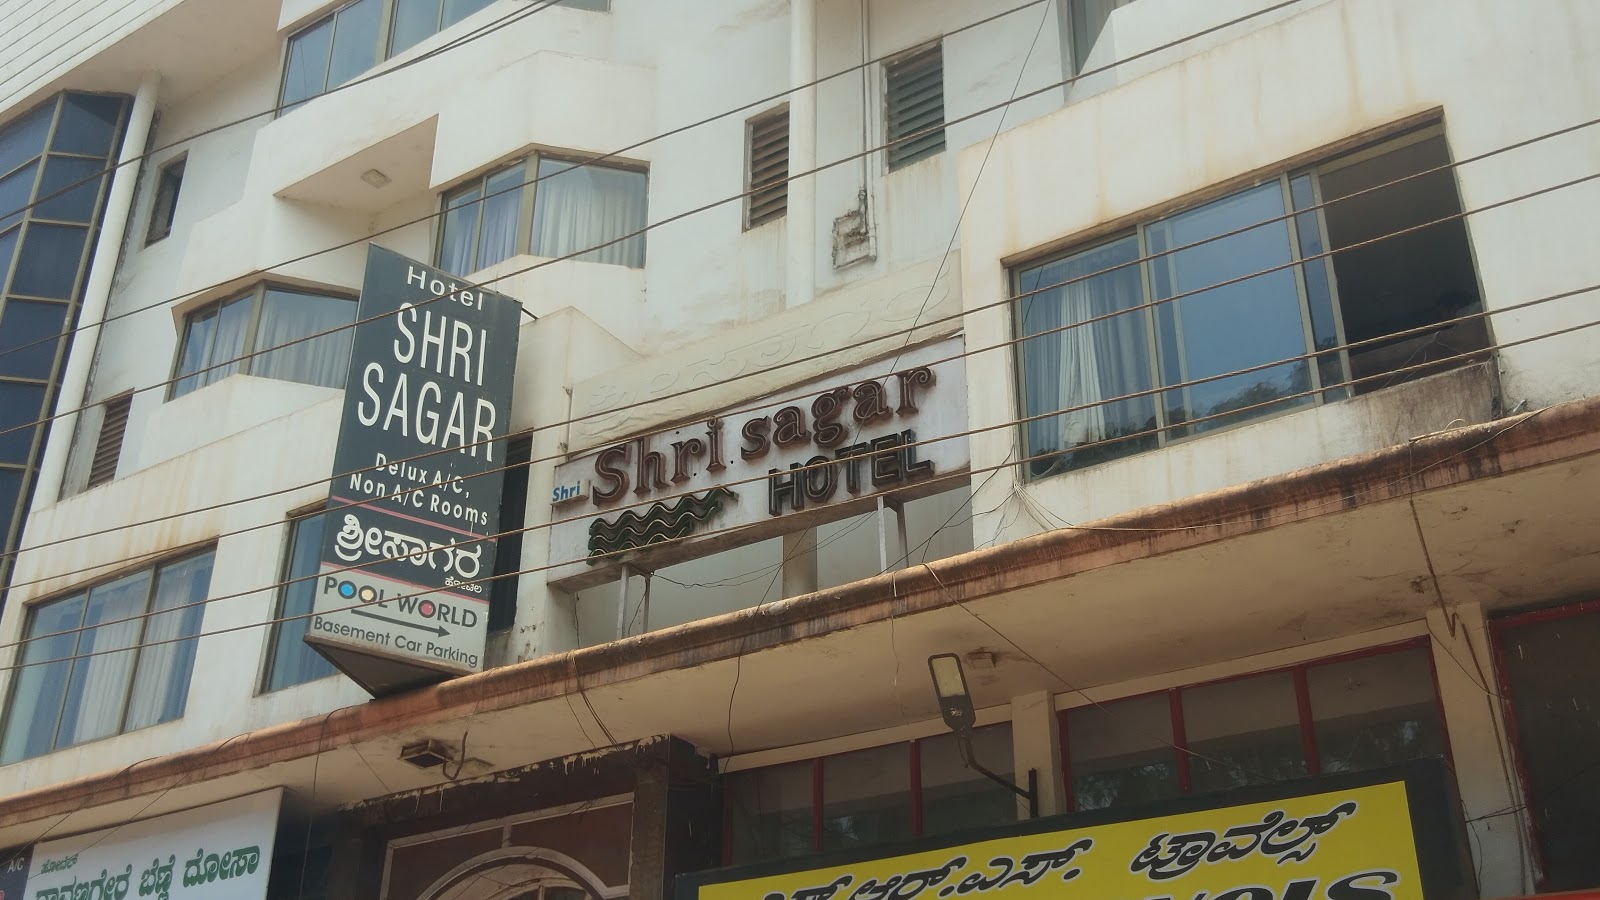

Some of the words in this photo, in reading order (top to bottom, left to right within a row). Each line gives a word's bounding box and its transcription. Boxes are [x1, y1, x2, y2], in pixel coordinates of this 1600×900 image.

[407, 265, 484, 311] Hotel
[393, 302, 487, 387] SHRI
[357, 362, 497, 462] SAGAR
[592, 415, 728, 507] Shri
[740, 365, 937, 462] sagar
[375, 452, 428, 485] Delux
[432, 470, 470, 499] A/C,
[552, 480, 580, 502] Shri
[768, 428, 935, 517] HOTEL
[350, 473, 386, 498] Non
[391, 483, 425, 509] A/C
[430, 493, 488, 526] Rooms
[323, 575, 389, 609] POOL
[397, 593, 478, 628] WORLD
[313, 616, 391, 646] Basement
[394, 634, 423, 654] Car
[425, 642, 479, 669] Parking
[182, 845, 260, 889] ದೋಸಾ
